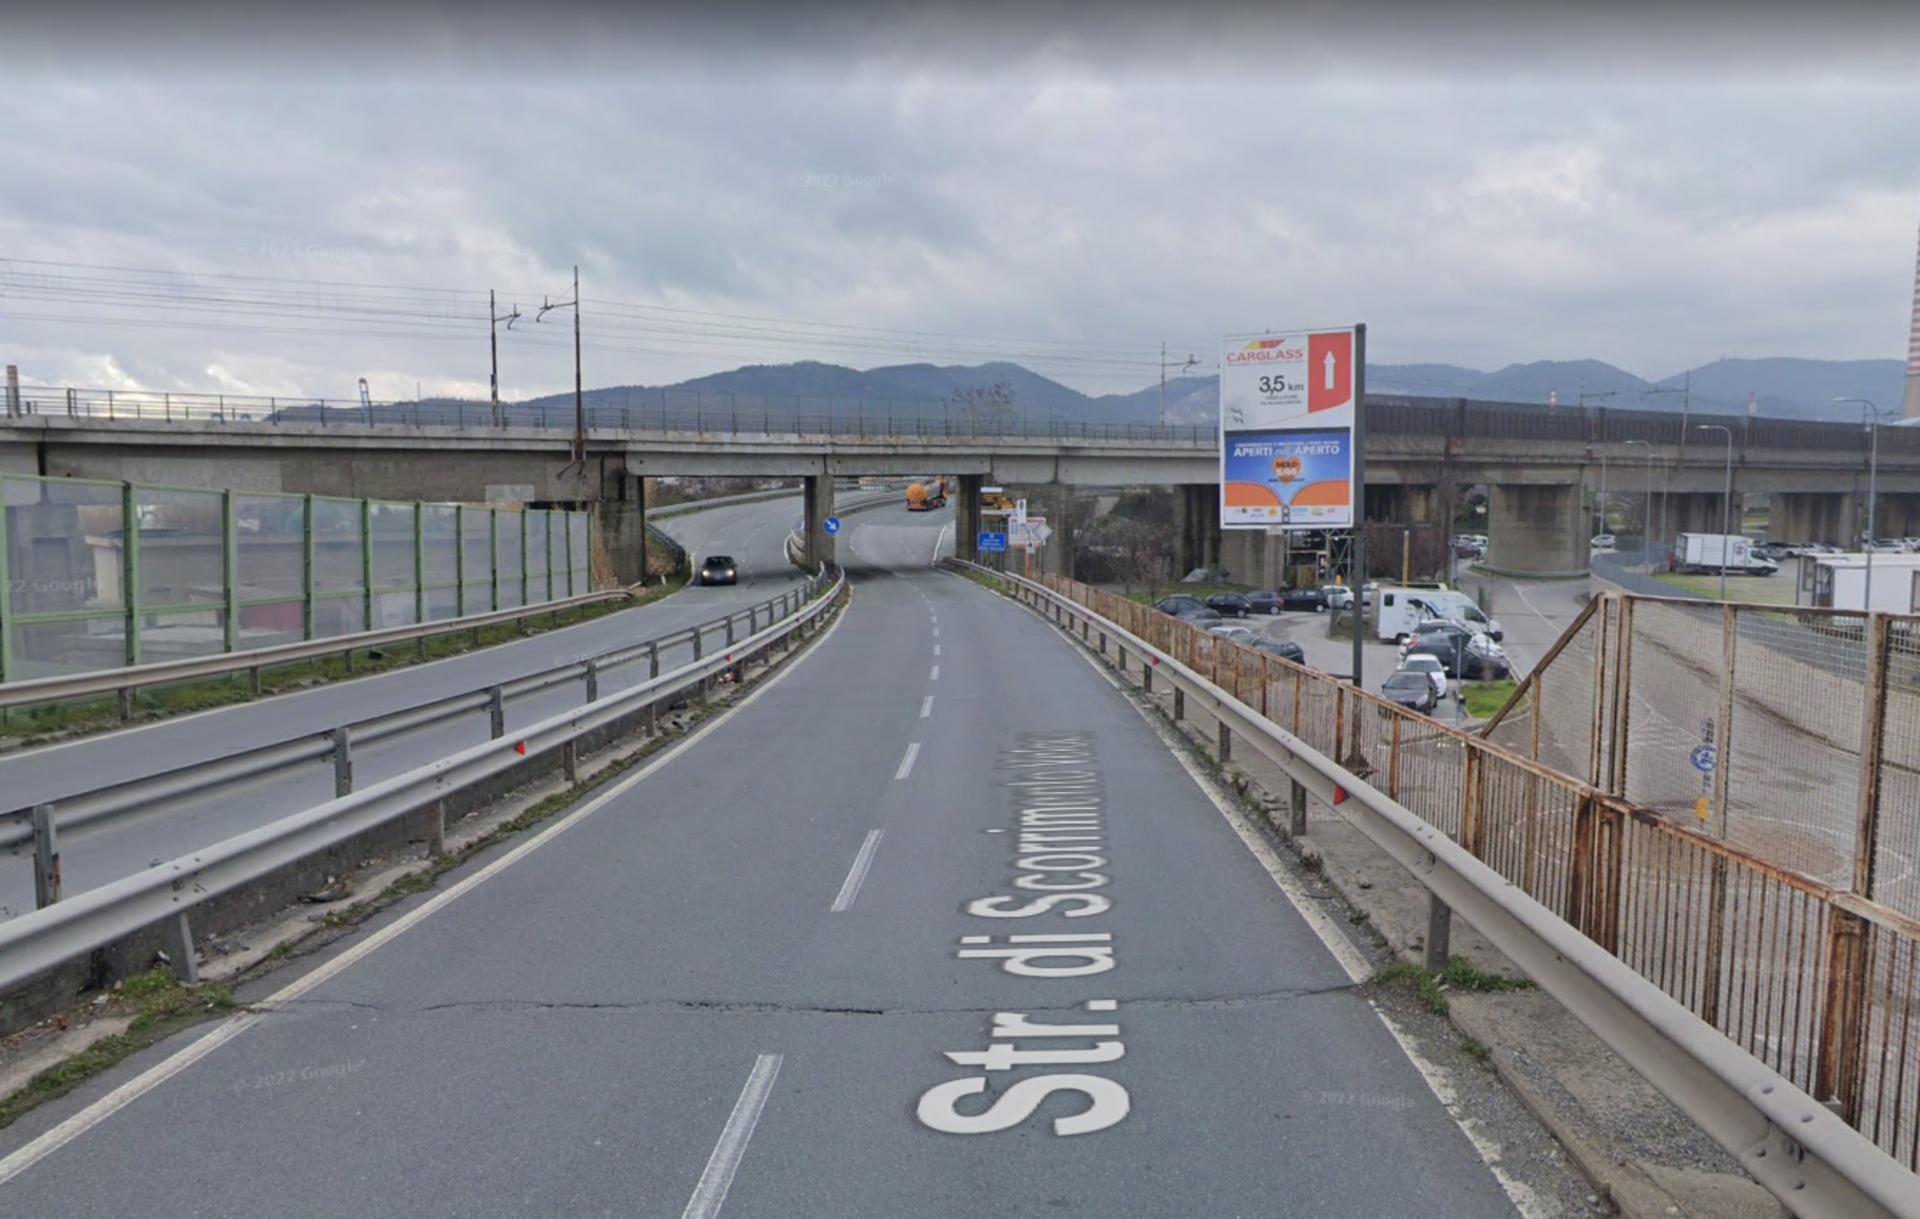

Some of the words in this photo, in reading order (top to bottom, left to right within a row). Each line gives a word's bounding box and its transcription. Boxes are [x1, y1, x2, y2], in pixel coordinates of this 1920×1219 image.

[1226, 349, 1303, 362] CARGLASS
[1259, 375, 1285, 395] 3,5
[1288, 383, 1304, 391] km
[1234, 447, 1272, 457] APERTI
